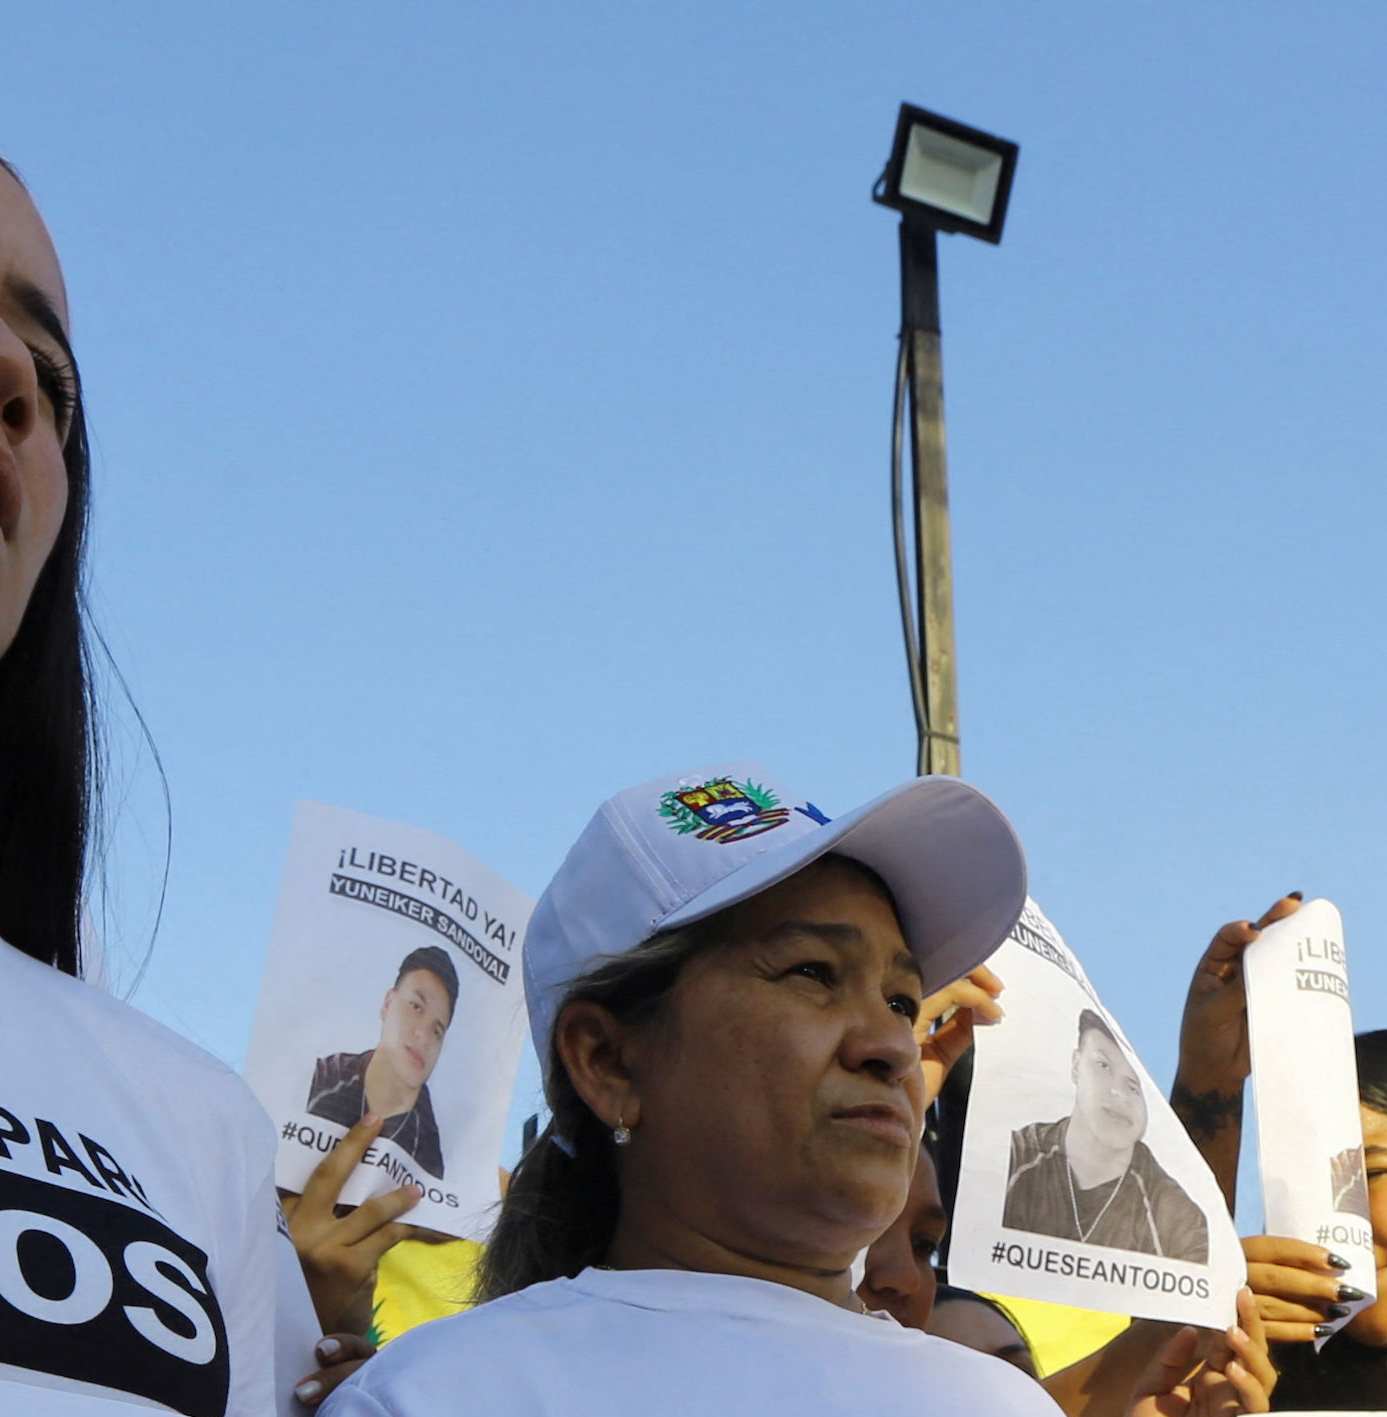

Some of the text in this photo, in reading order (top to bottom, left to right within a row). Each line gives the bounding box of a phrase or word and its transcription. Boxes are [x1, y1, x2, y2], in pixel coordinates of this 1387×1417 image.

[338, 847, 516, 952] ¡LIBERTAD YA!
[330, 876, 508, 984] YUNEIKER SANDOVAL
[1297, 936, 1347, 967] ¡LIB
[1316, 1225, 1374, 1252] #QUE
[991, 1241, 1210, 1299] #QUESEANTODOS
